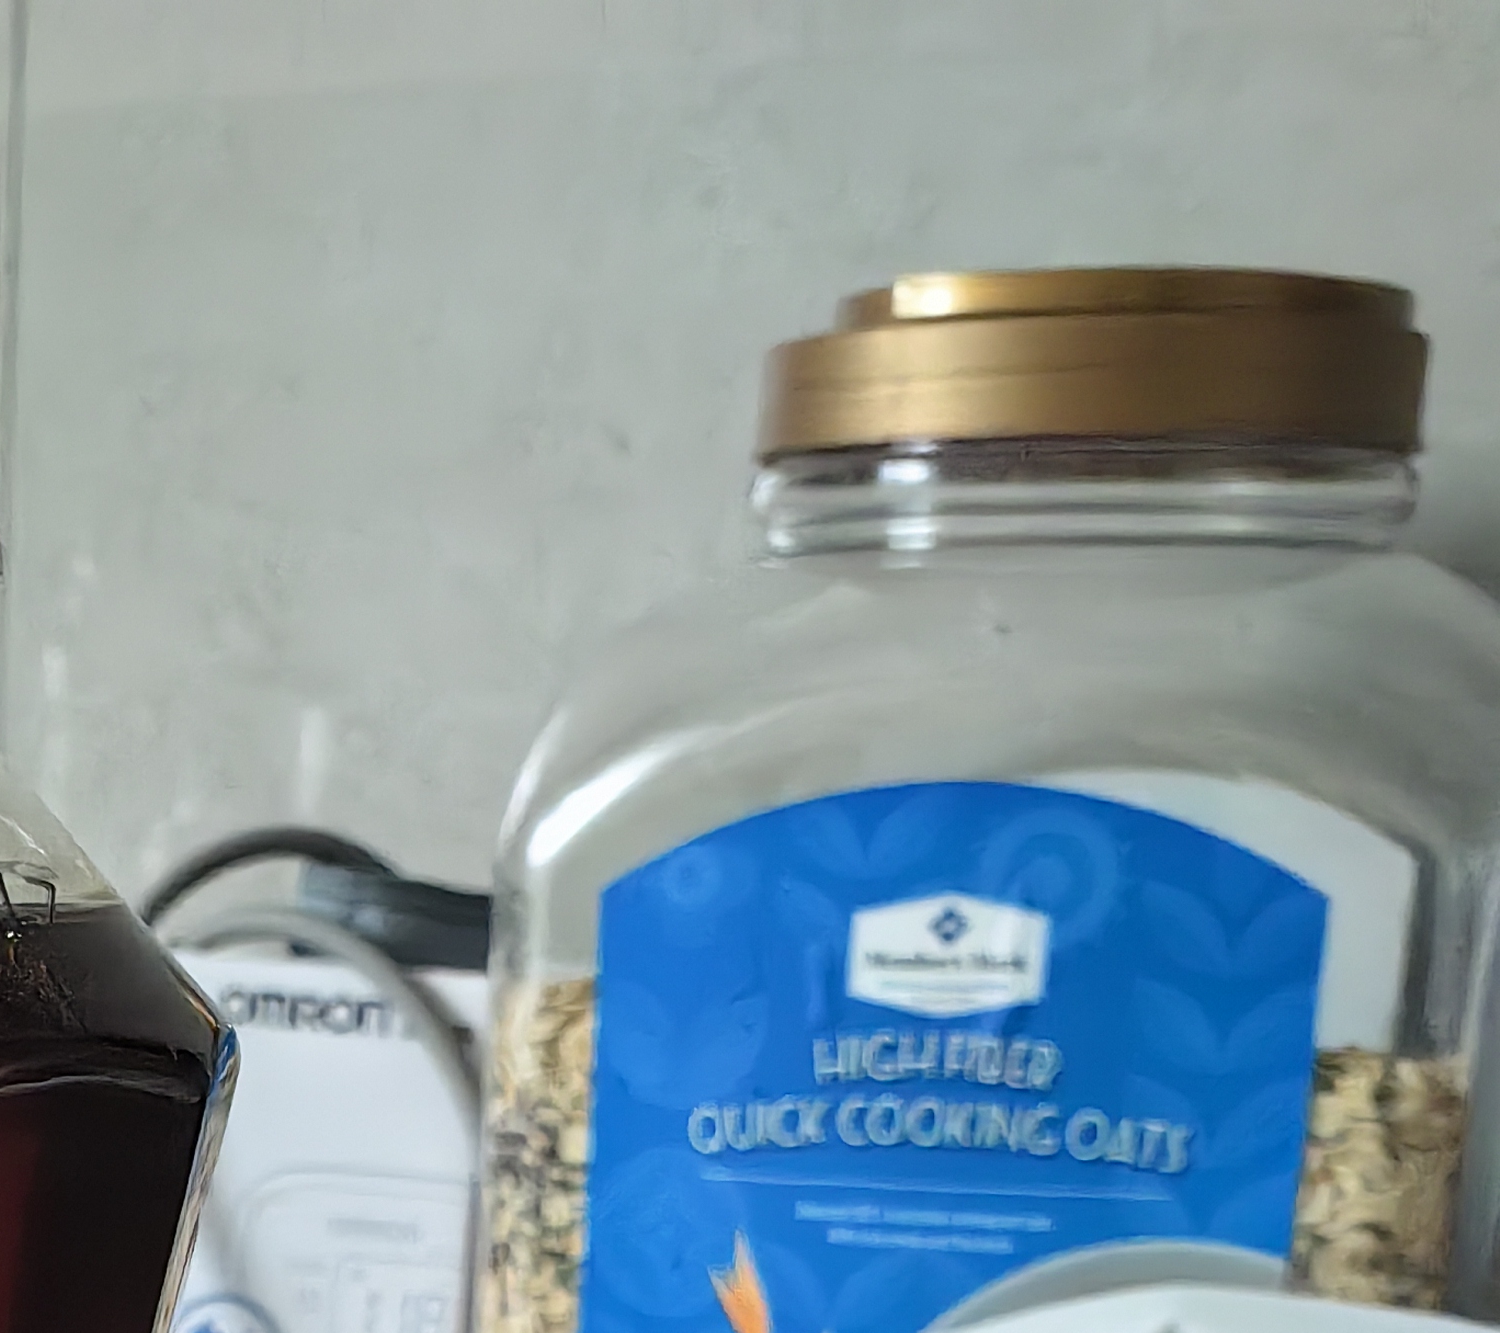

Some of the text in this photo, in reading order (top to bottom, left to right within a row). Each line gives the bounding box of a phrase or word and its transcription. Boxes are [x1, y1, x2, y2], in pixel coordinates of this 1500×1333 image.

[687, 1093, 1192, 1174] QUICK COOKING OATS
